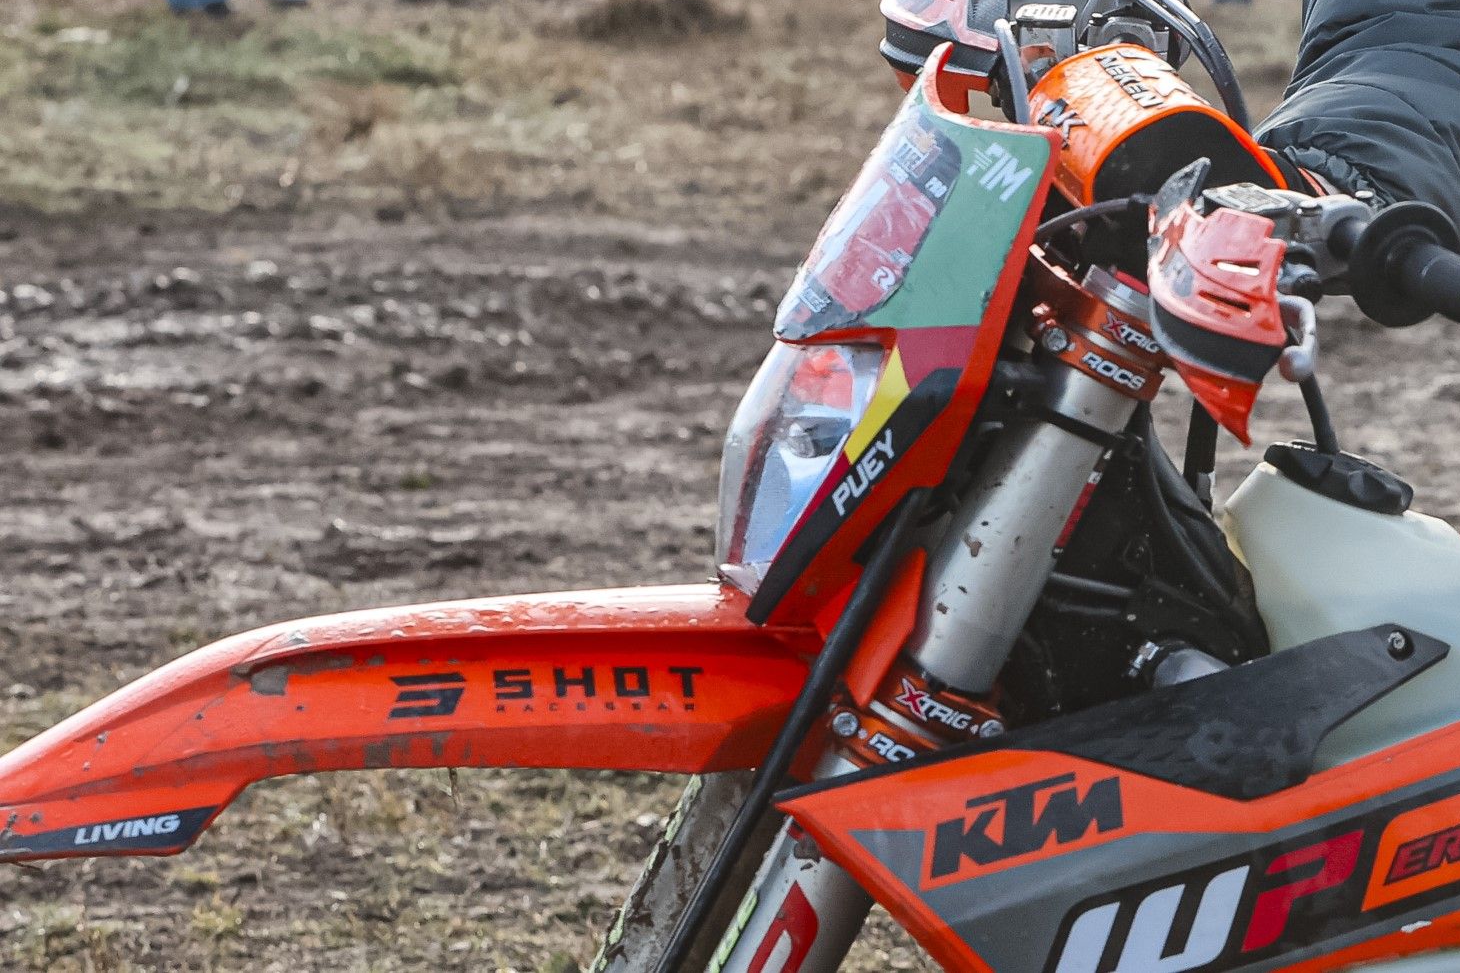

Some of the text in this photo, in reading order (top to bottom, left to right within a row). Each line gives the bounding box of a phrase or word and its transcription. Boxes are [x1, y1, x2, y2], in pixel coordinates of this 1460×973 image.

[1096, 55, 1163, 108] NEKEN
[967, 143, 1033, 202] FIM
[1103, 310, 1160, 353] XTRIG
[1081, 351, 1145, 390] ROCS
[832, 428, 895, 516] PUEY
[493, 666, 704, 699] SHOT
[895, 678, 972, 730] XTRIG
[74, 815, 180, 845] LIVING
[930, 772, 1123, 880] KTM
